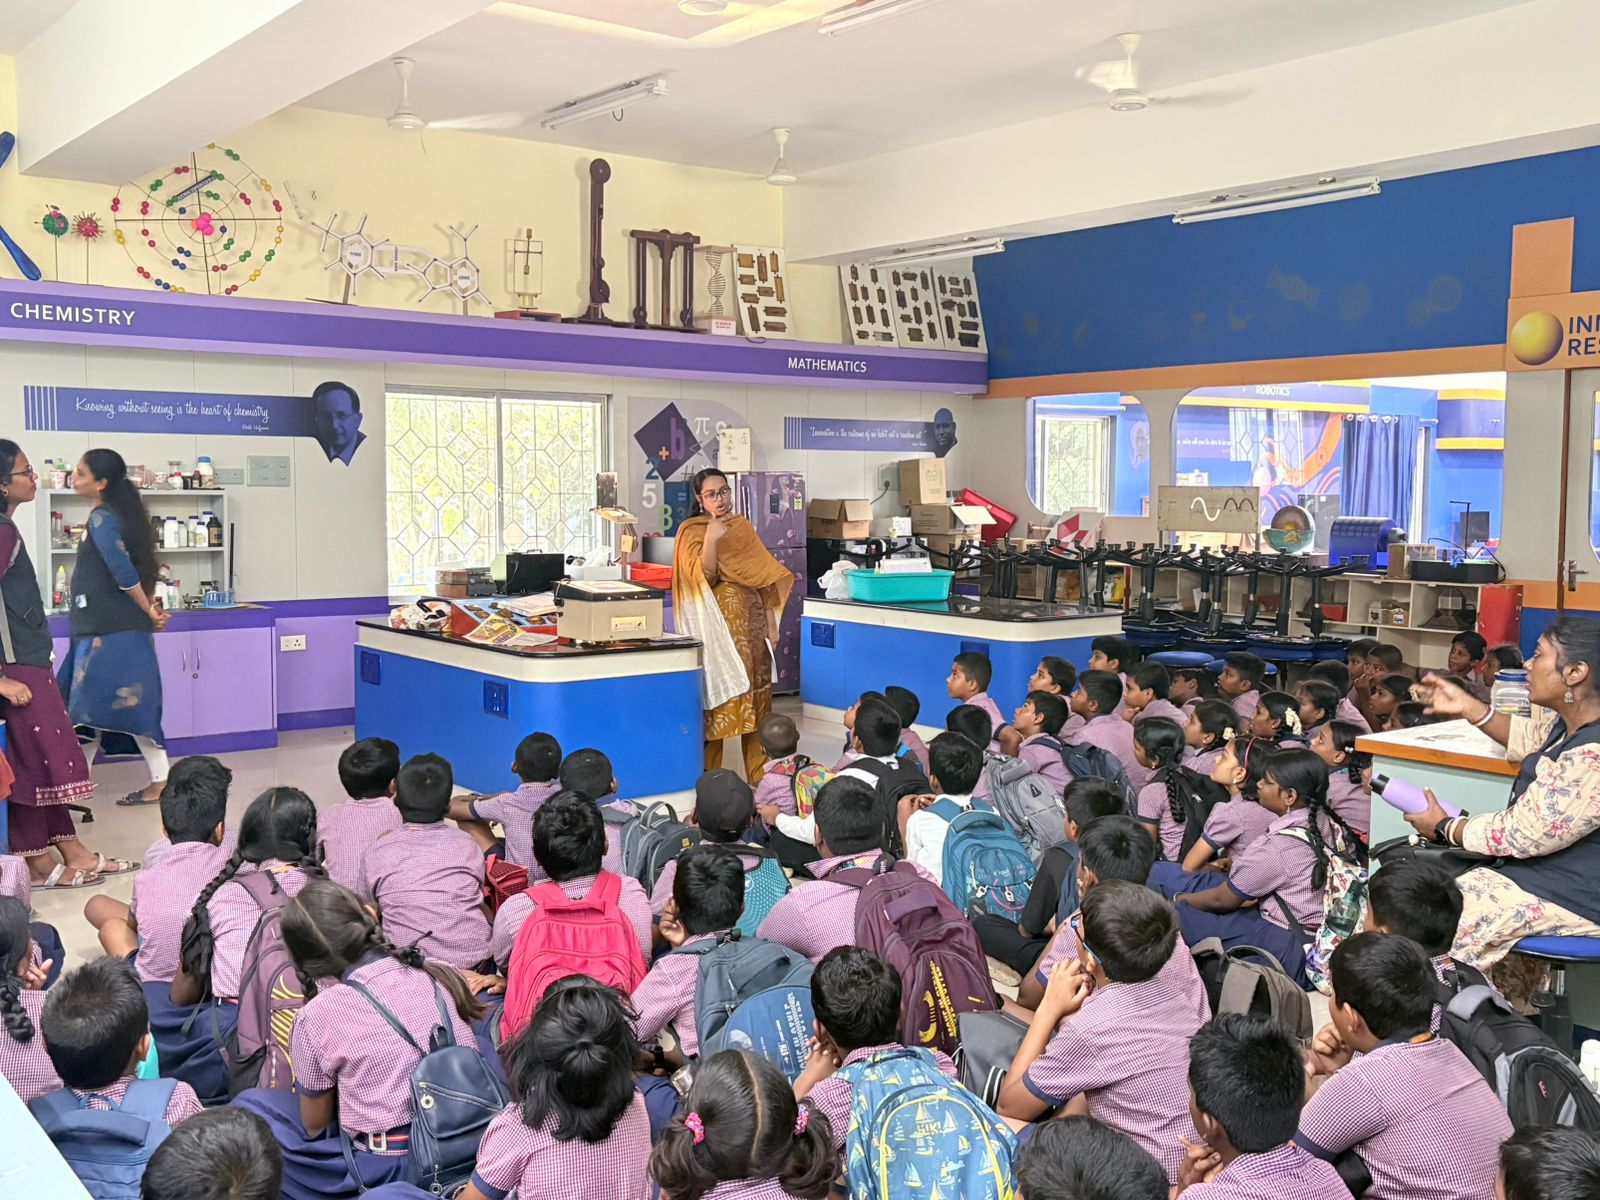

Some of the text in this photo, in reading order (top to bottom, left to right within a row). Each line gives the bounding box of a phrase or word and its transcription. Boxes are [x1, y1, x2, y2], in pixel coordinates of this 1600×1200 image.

[10, 302, 136, 326] CHEMISTRY
[1567, 337, 1600, 356] RE
[787, 357, 868, 373] MATHEMATICS
[1255, 384, 1291, 397] ROBOTICS
[76, 396, 270, 424] Knowing without seeing is the heart of chemistry
[641, 482, 658, 509] 5
